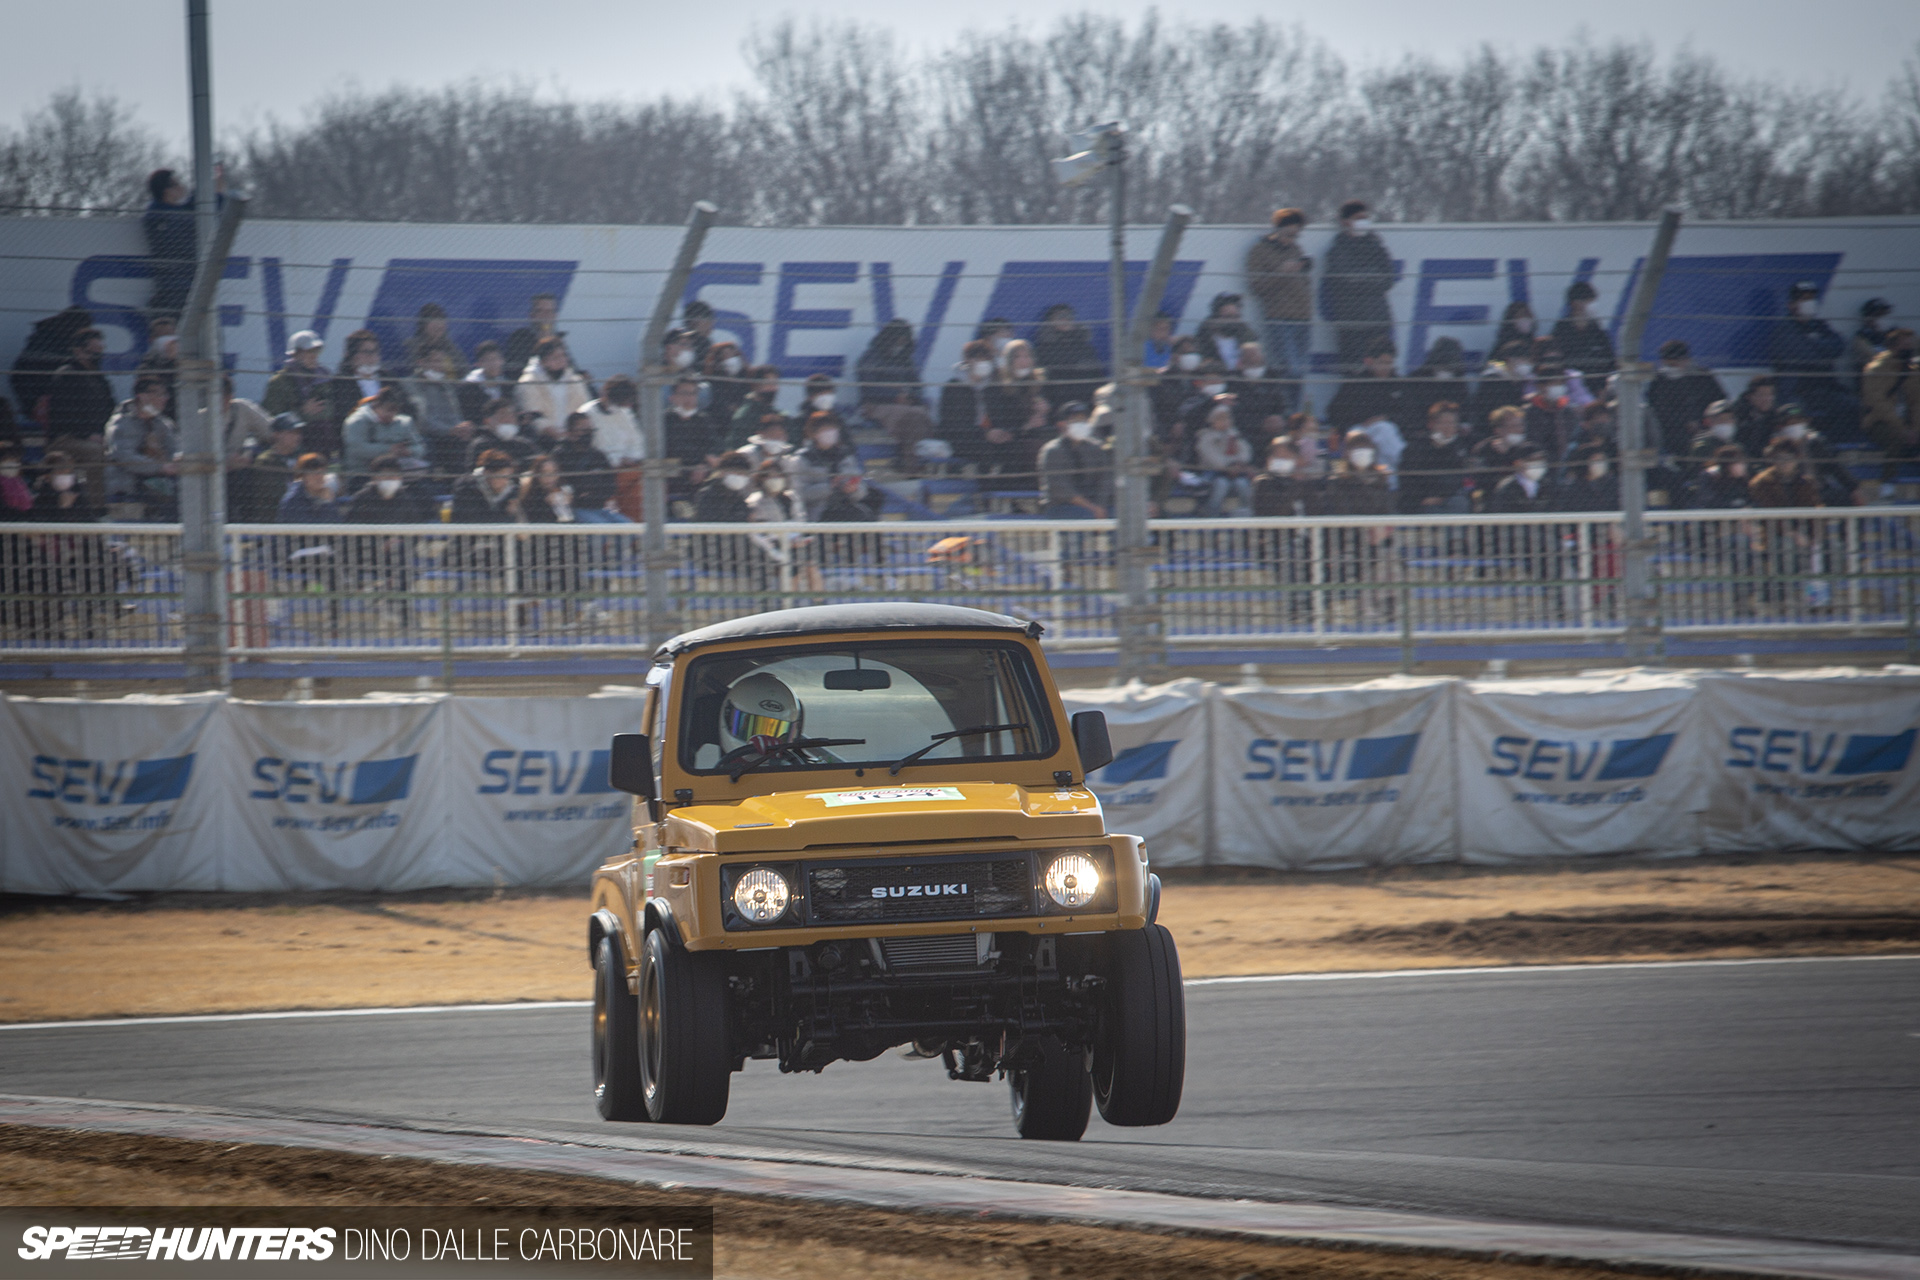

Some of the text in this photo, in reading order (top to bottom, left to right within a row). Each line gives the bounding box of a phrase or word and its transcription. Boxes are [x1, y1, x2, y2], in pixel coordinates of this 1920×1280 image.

[682, 261, 966, 378] SEV
[477, 749, 580, 794] SEV
[1243, 738, 1345, 781] SEV
[1486, 736, 1600, 780] SEV
[1726, 727, 1837, 774] SEV
[27, 755, 129, 804] SEV
[250, 757, 349, 803] SEV
[871, 883, 967, 898] SUZUKI
